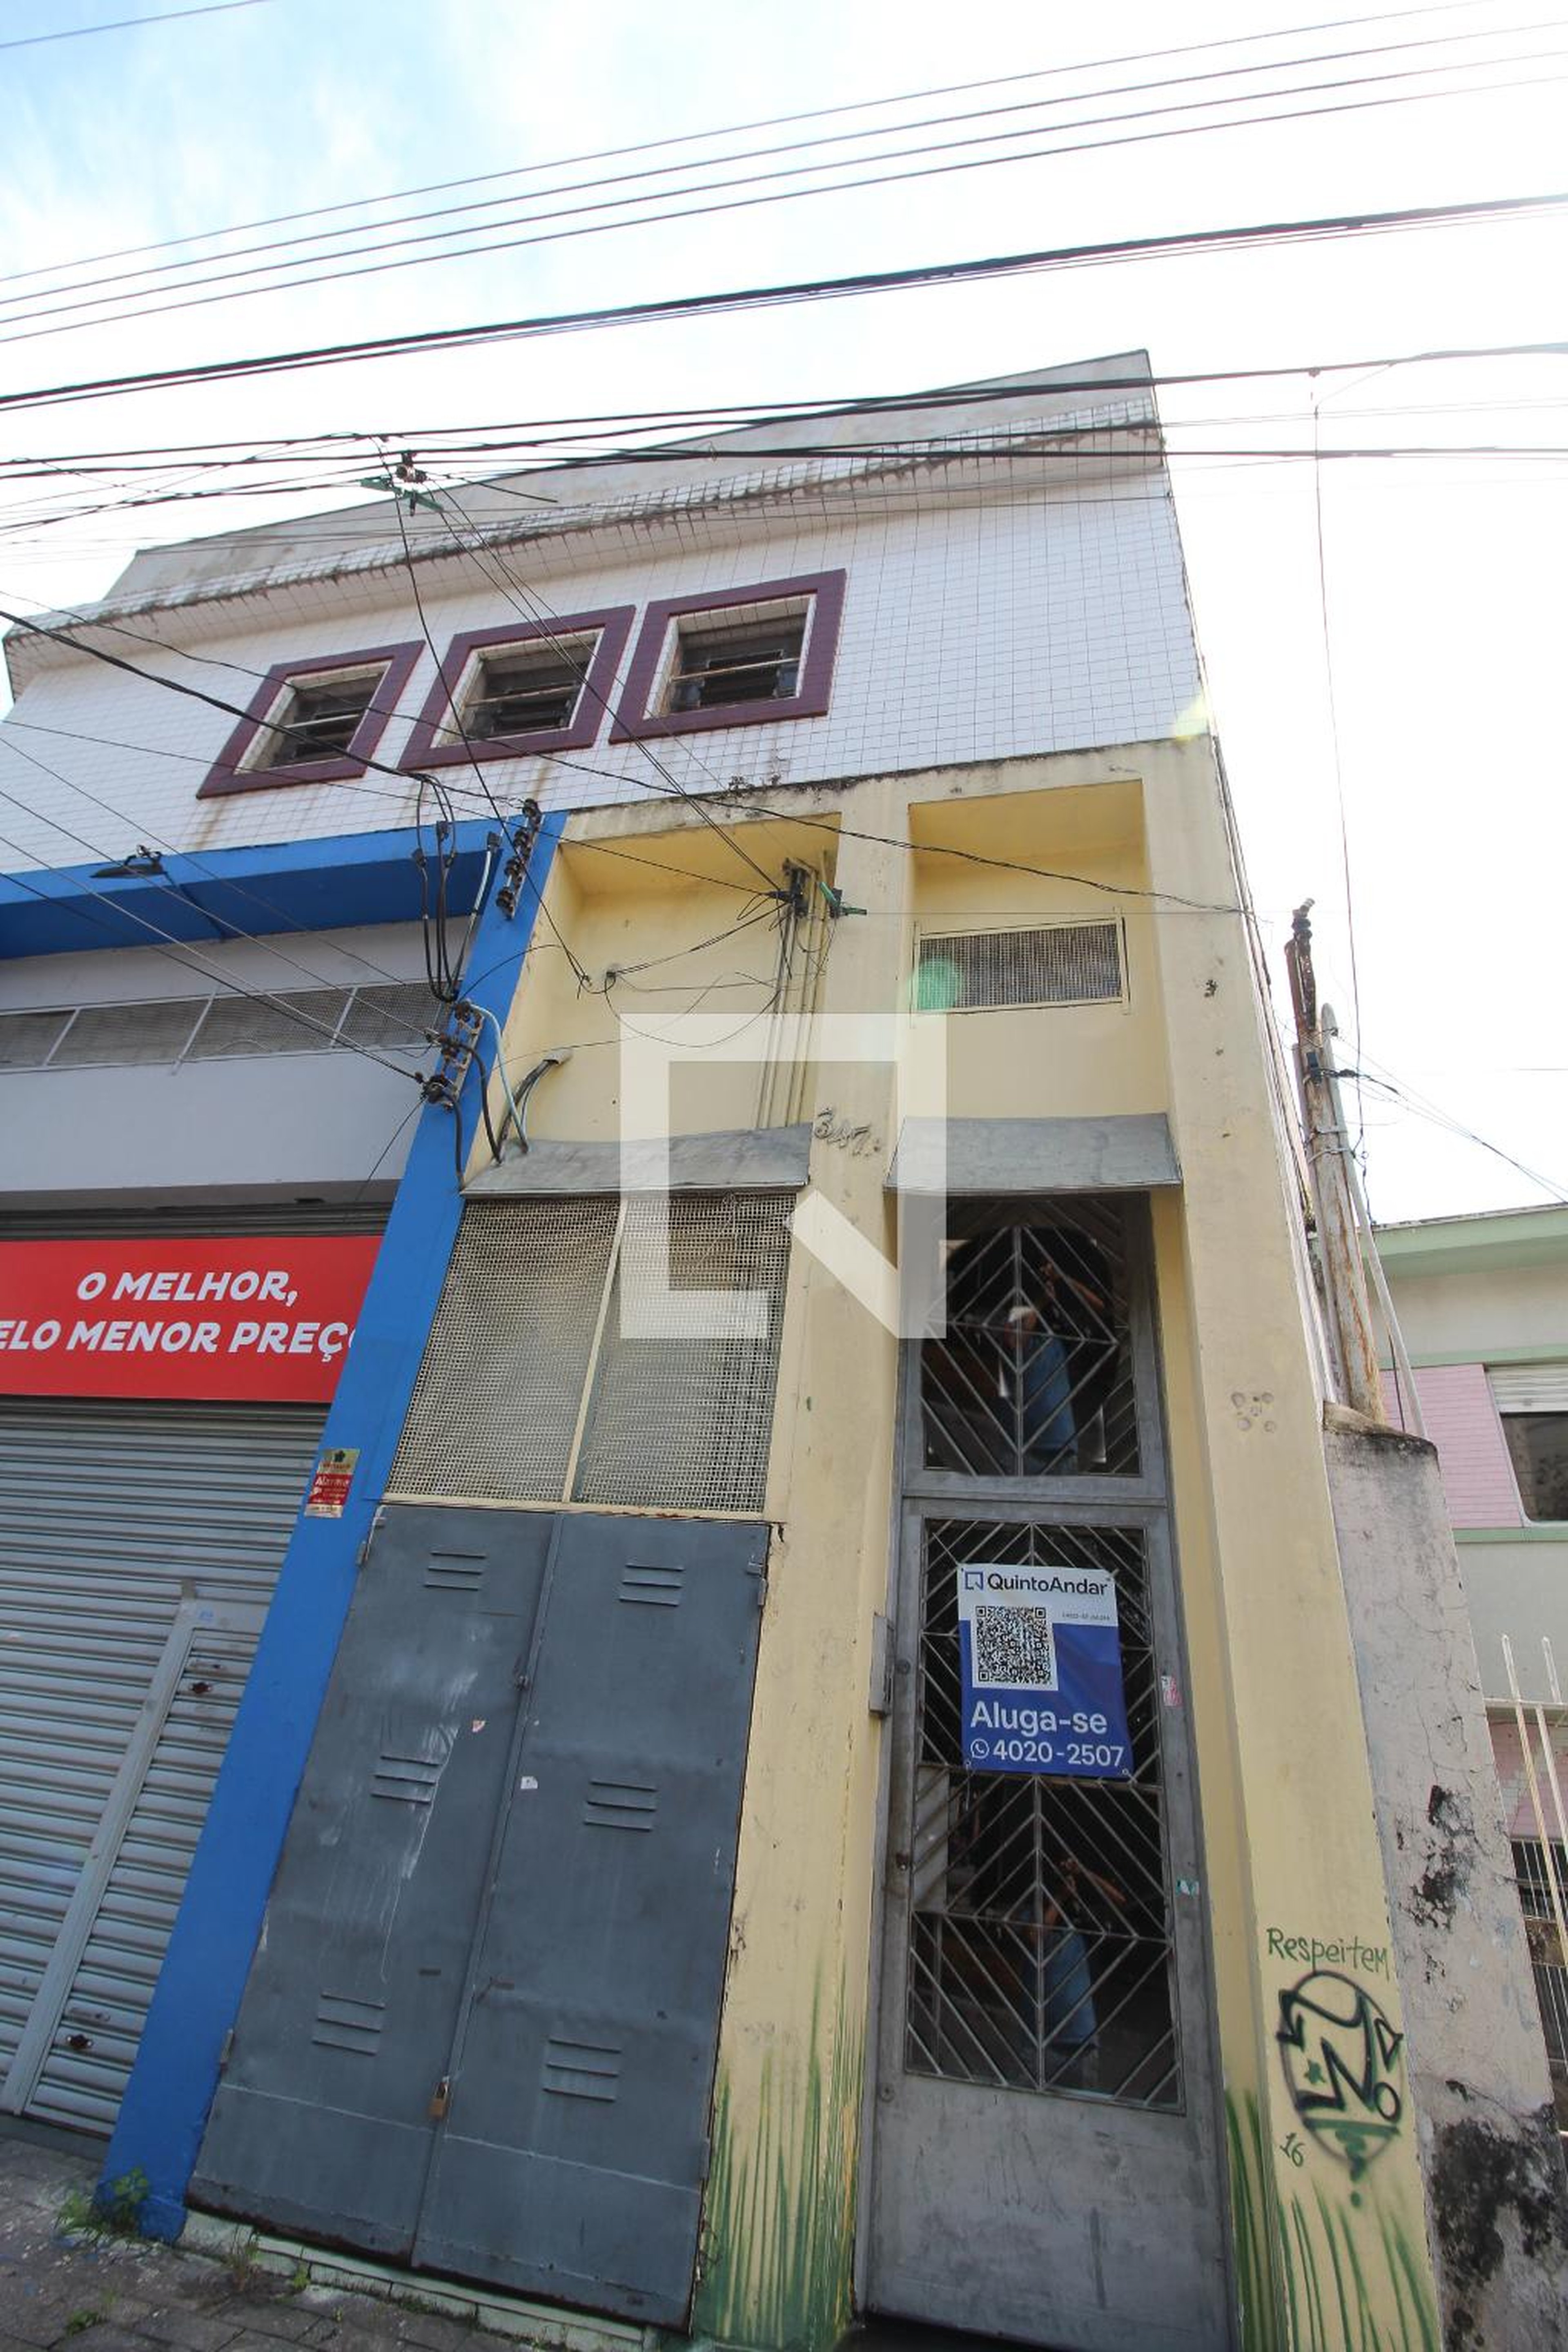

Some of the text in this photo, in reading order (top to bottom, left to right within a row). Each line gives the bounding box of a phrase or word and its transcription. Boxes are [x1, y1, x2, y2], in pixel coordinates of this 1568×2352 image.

[76, 1271, 298, 1307] O MELHOR,
[66, 1320, 220, 1353] MENOR
[228, 1322, 356, 1362] PREÇ
[987, 1572, 1107, 1596] QuintoAndar
[970, 1701, 1107, 1737] Aluga-se
[1279, 2132, 1306, 2168] 16
